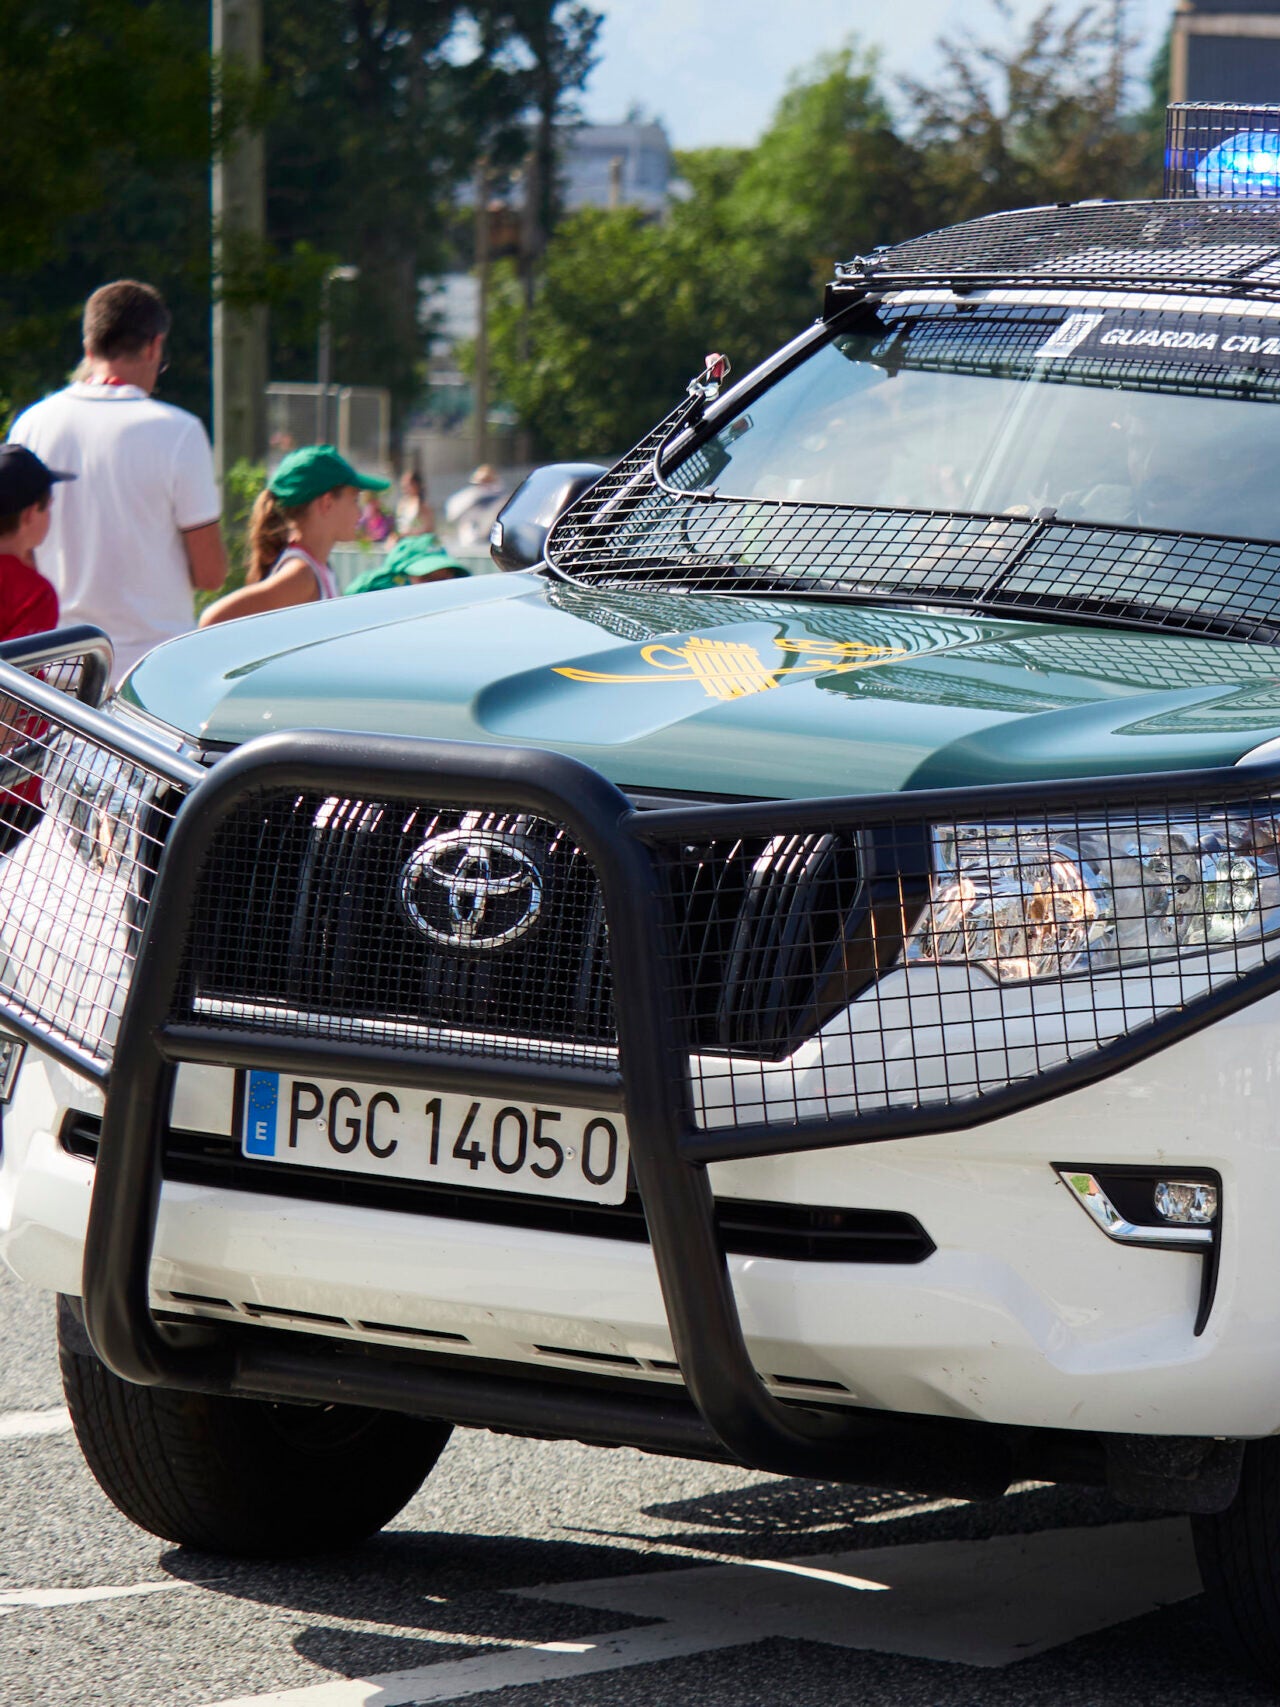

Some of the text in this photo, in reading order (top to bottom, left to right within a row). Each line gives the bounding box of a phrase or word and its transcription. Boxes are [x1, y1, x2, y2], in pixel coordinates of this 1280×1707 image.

[1100, 328, 1219, 350] GUARDIA
[288, 1080, 400, 1159] PGC
[255, 1121, 267, 1142] E
